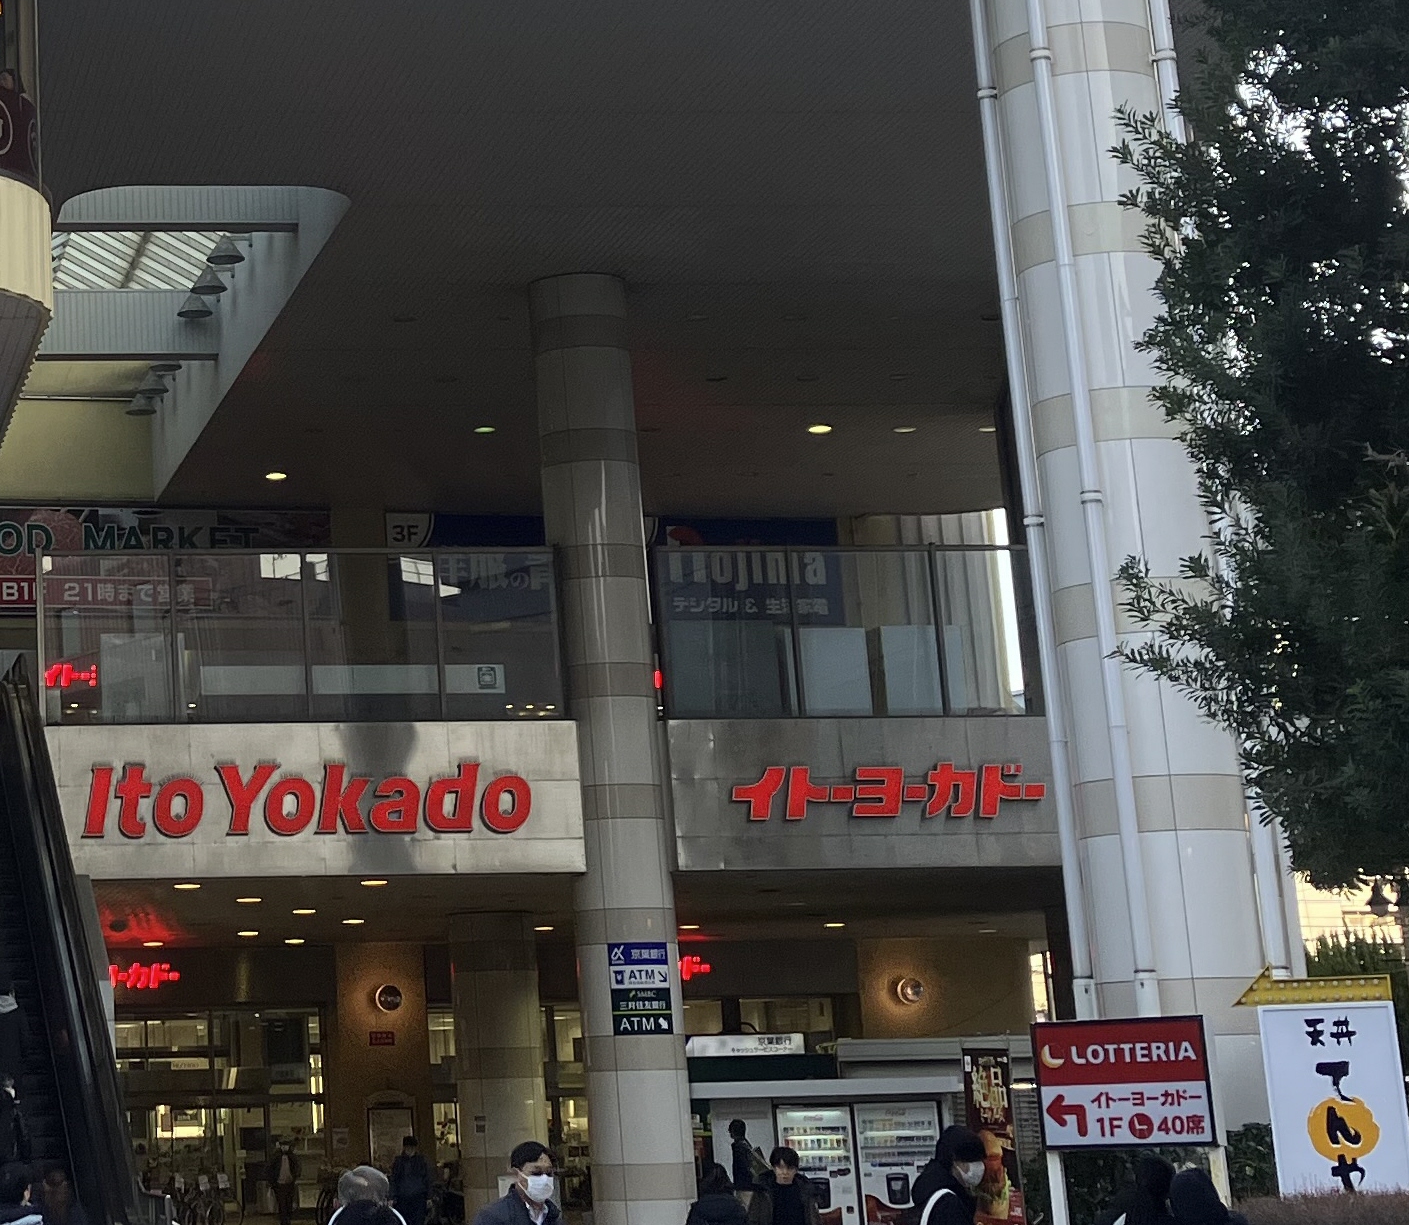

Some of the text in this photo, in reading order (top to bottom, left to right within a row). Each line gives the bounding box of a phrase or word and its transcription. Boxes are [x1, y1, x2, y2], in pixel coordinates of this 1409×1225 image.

[82, 522, 260, 551] MARKET
[391, 524, 419, 543] 3F
[82, 762, 533, 839] Ito Yokado
[731, 761, 1047, 822] イトーヨーカドー
[628, 969, 656, 981] ATM
[619, 1016, 655, 1032] ATM
[1070, 1039, 1198, 1066] LOTTERIA
[1090, 1090, 1203, 1110] イトーヨーカドー
[1096, 1116, 1124, 1139] 1F
[1156, 1114, 1206, 1137] 40席
